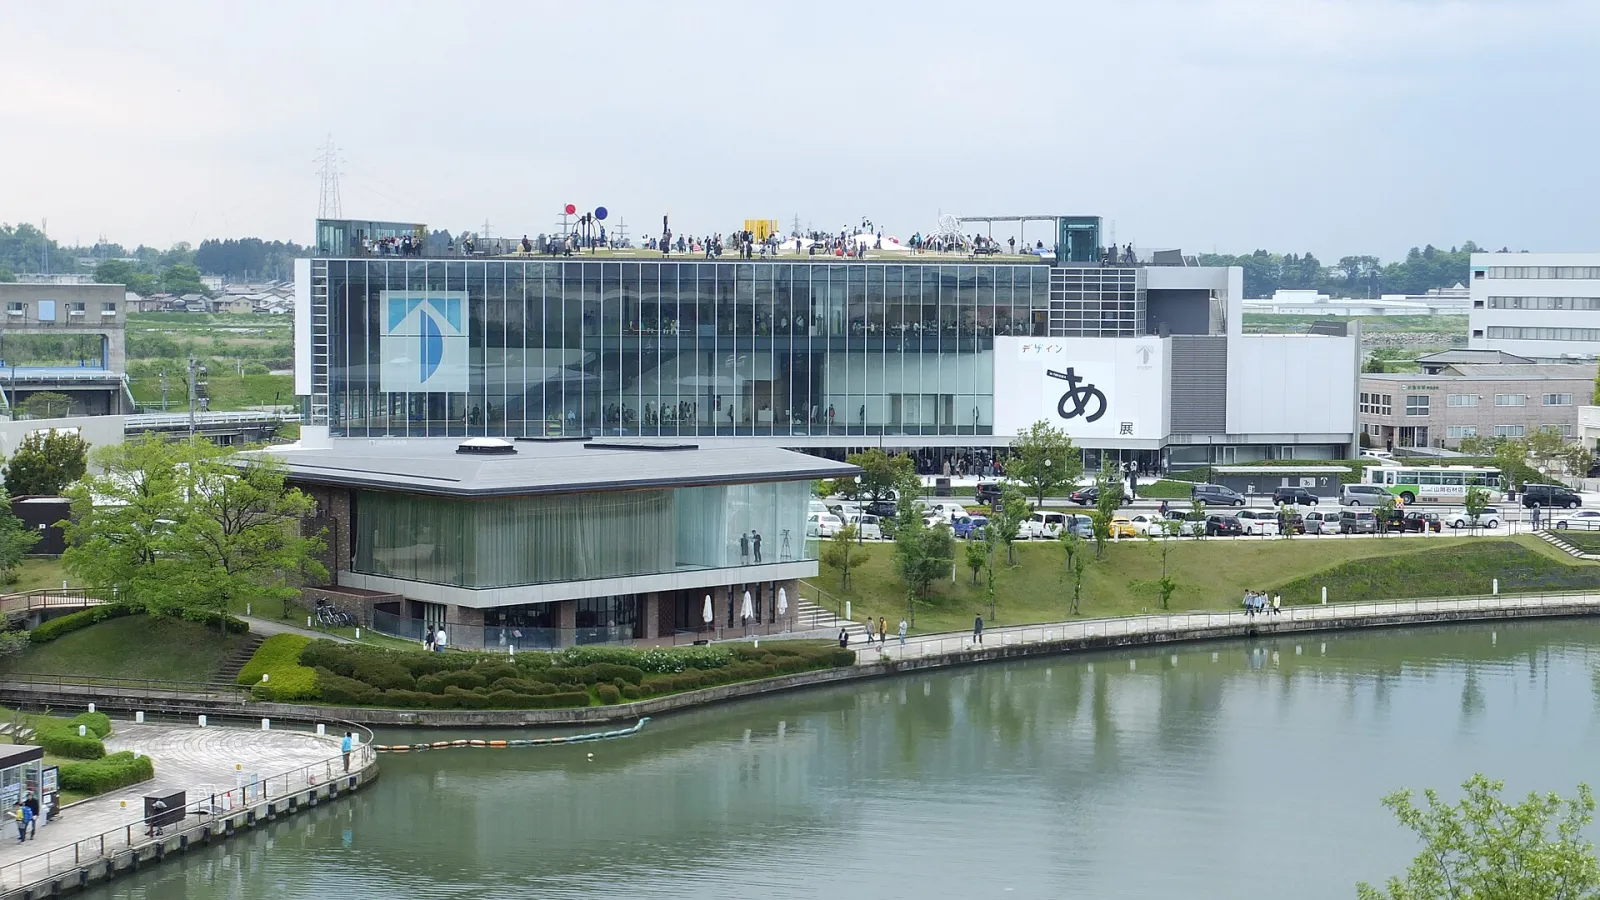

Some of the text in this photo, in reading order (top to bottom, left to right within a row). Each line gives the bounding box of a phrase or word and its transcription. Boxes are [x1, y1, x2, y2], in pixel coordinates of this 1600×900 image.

[1022, 343, 1063, 354] デザイン
[1046, 367, 1107, 423] あ
[1119, 421, 1134, 436] 展
